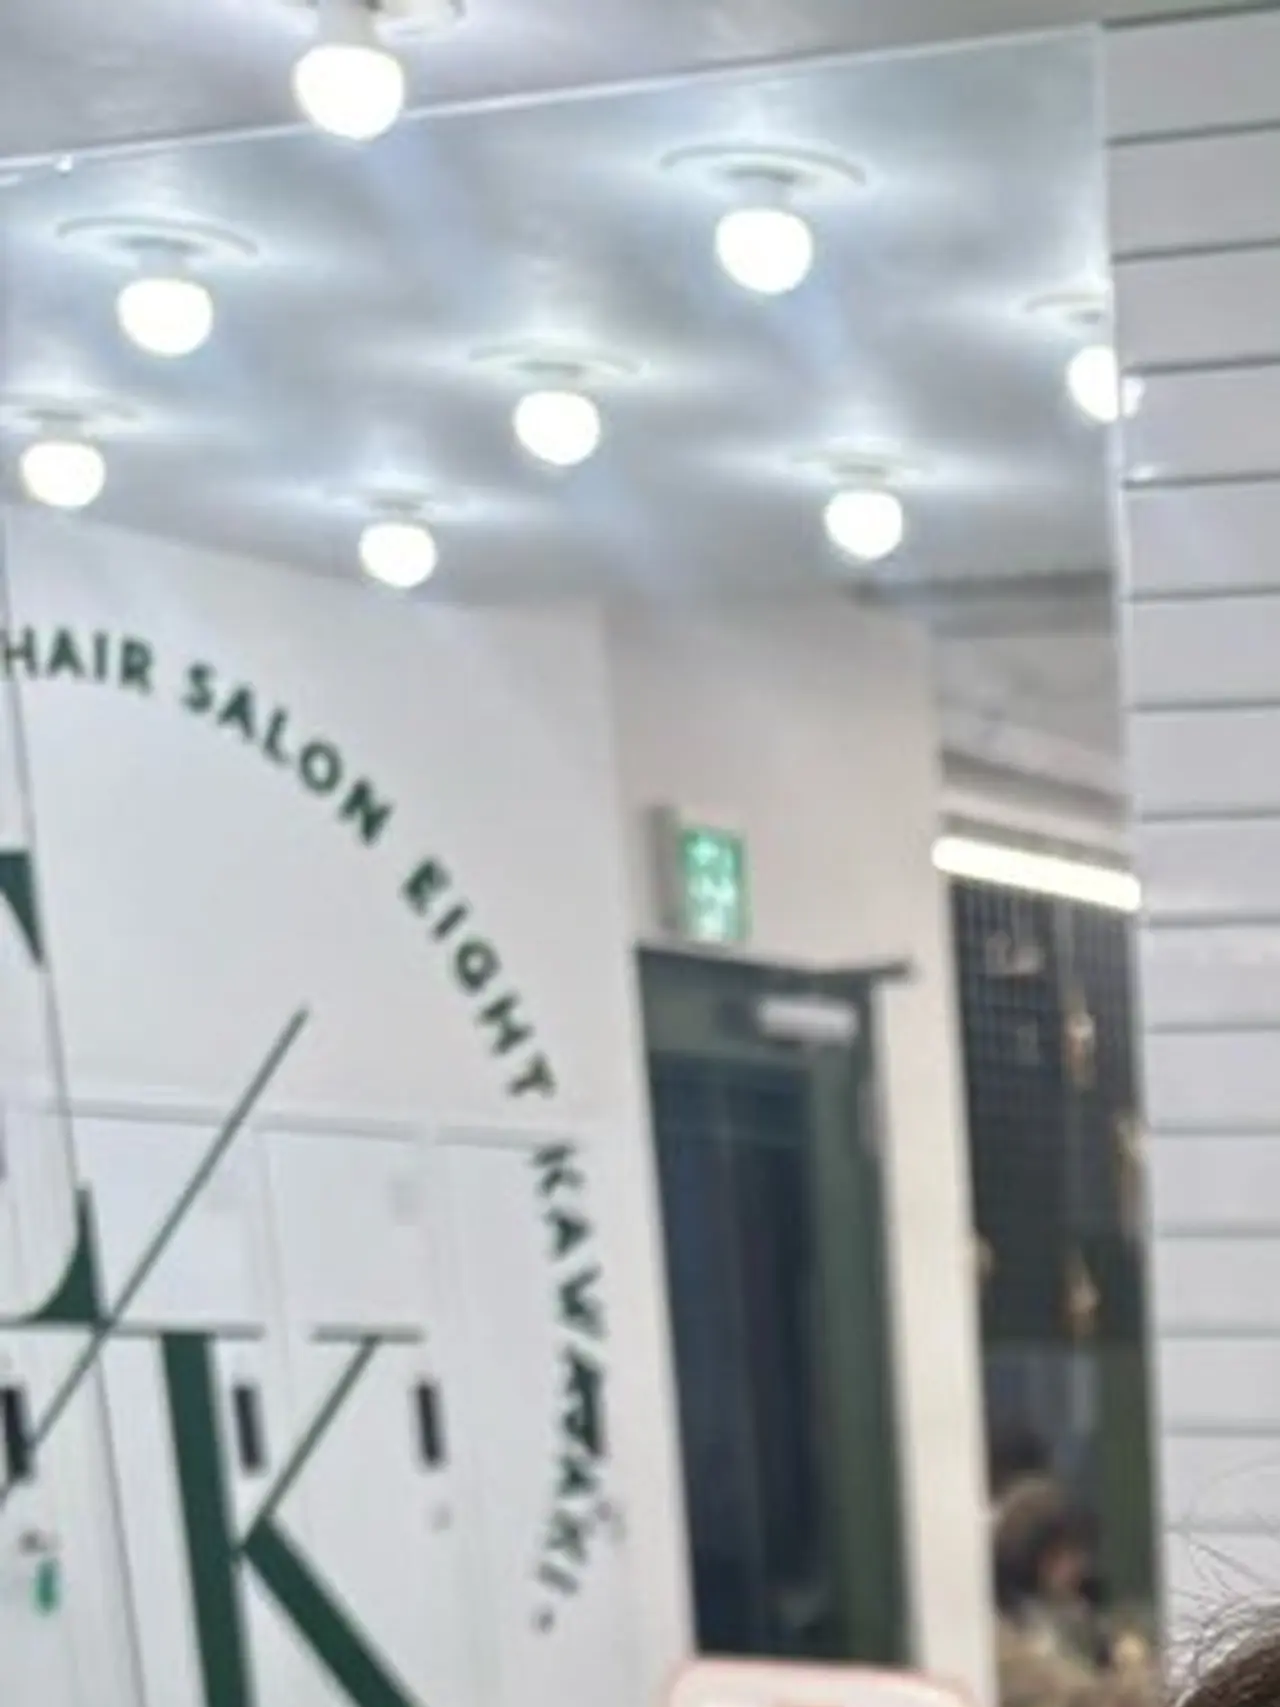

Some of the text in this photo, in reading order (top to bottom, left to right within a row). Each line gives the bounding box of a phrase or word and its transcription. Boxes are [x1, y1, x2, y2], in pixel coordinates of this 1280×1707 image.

[0, 626, 156, 695] HAIR
[180, 663, 394, 847] SALON
[400, 859, 557, 1101] EIGHT
